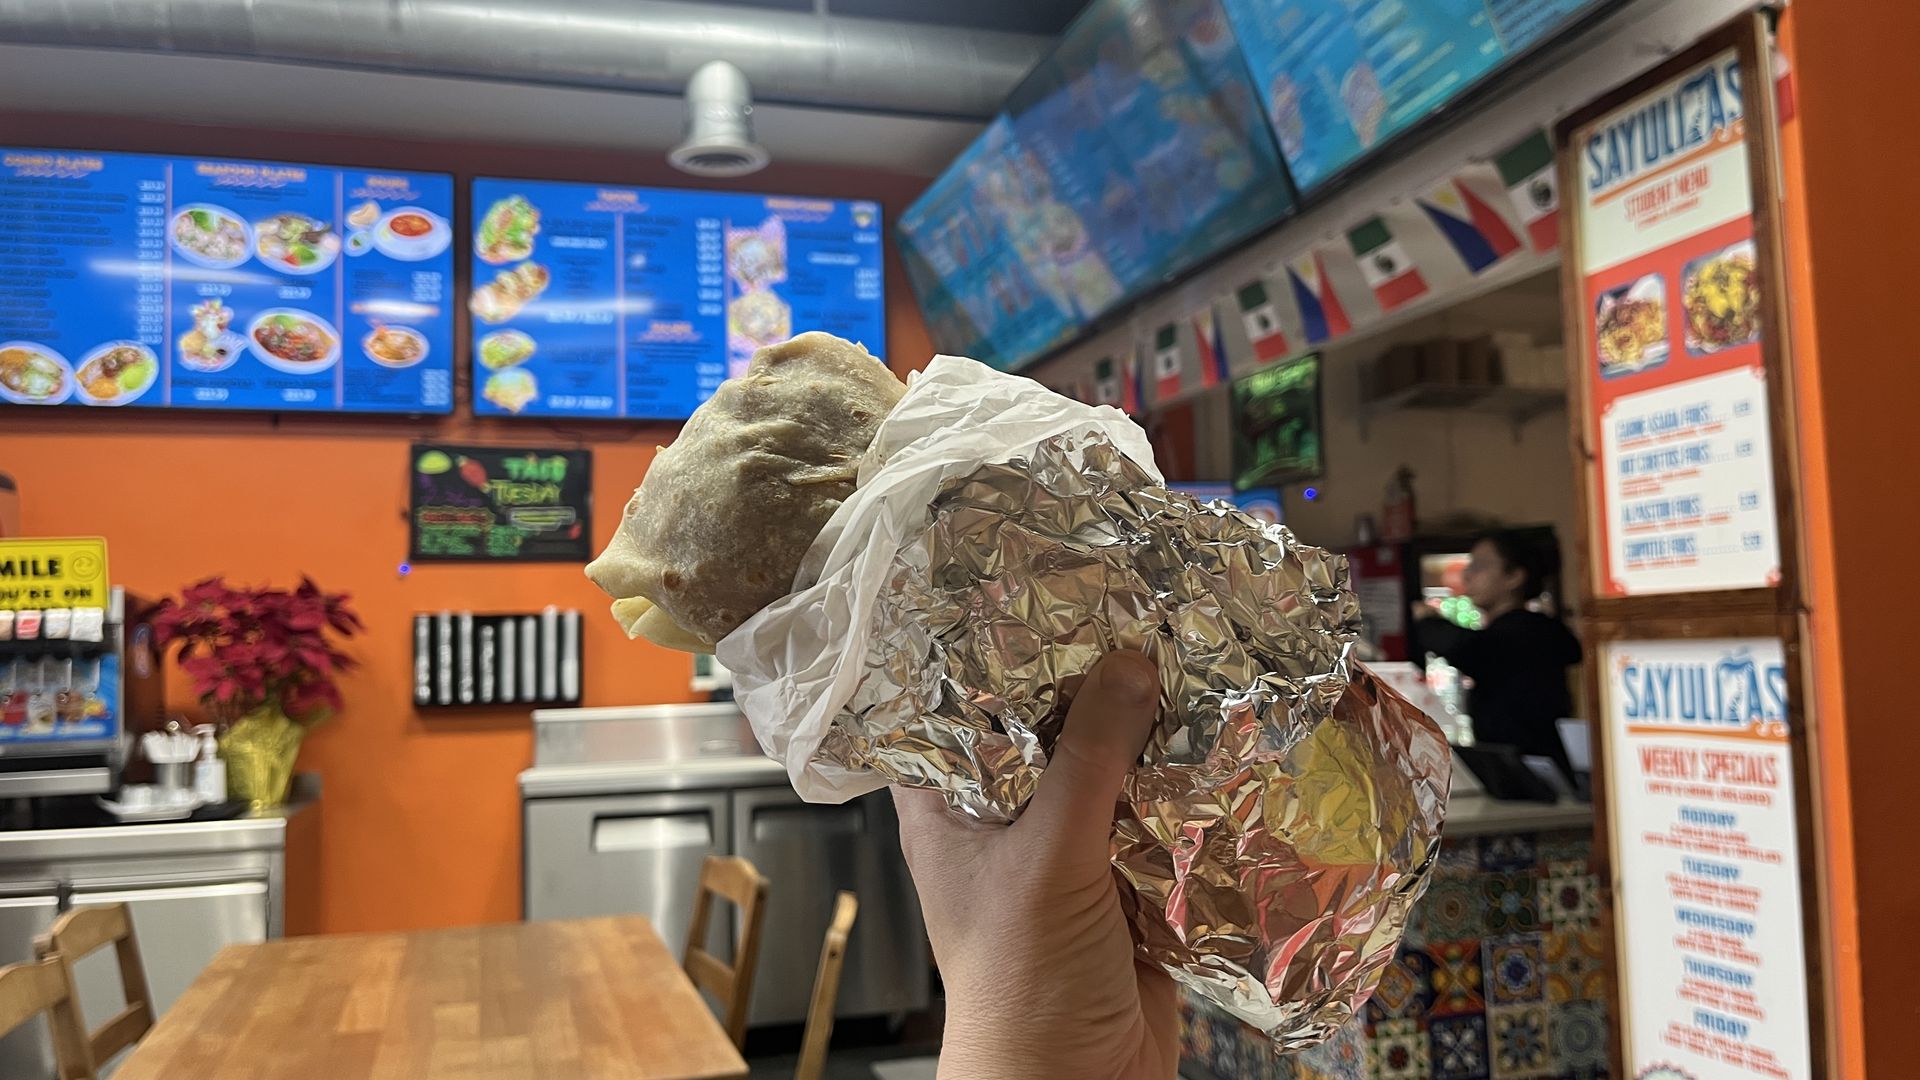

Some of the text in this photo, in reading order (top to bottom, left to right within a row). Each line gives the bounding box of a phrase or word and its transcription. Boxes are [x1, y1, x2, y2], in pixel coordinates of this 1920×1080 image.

[1640, 746, 1777, 786] WEEKLY SPECIALS
[1680, 806, 1736, 827] MONDAY
